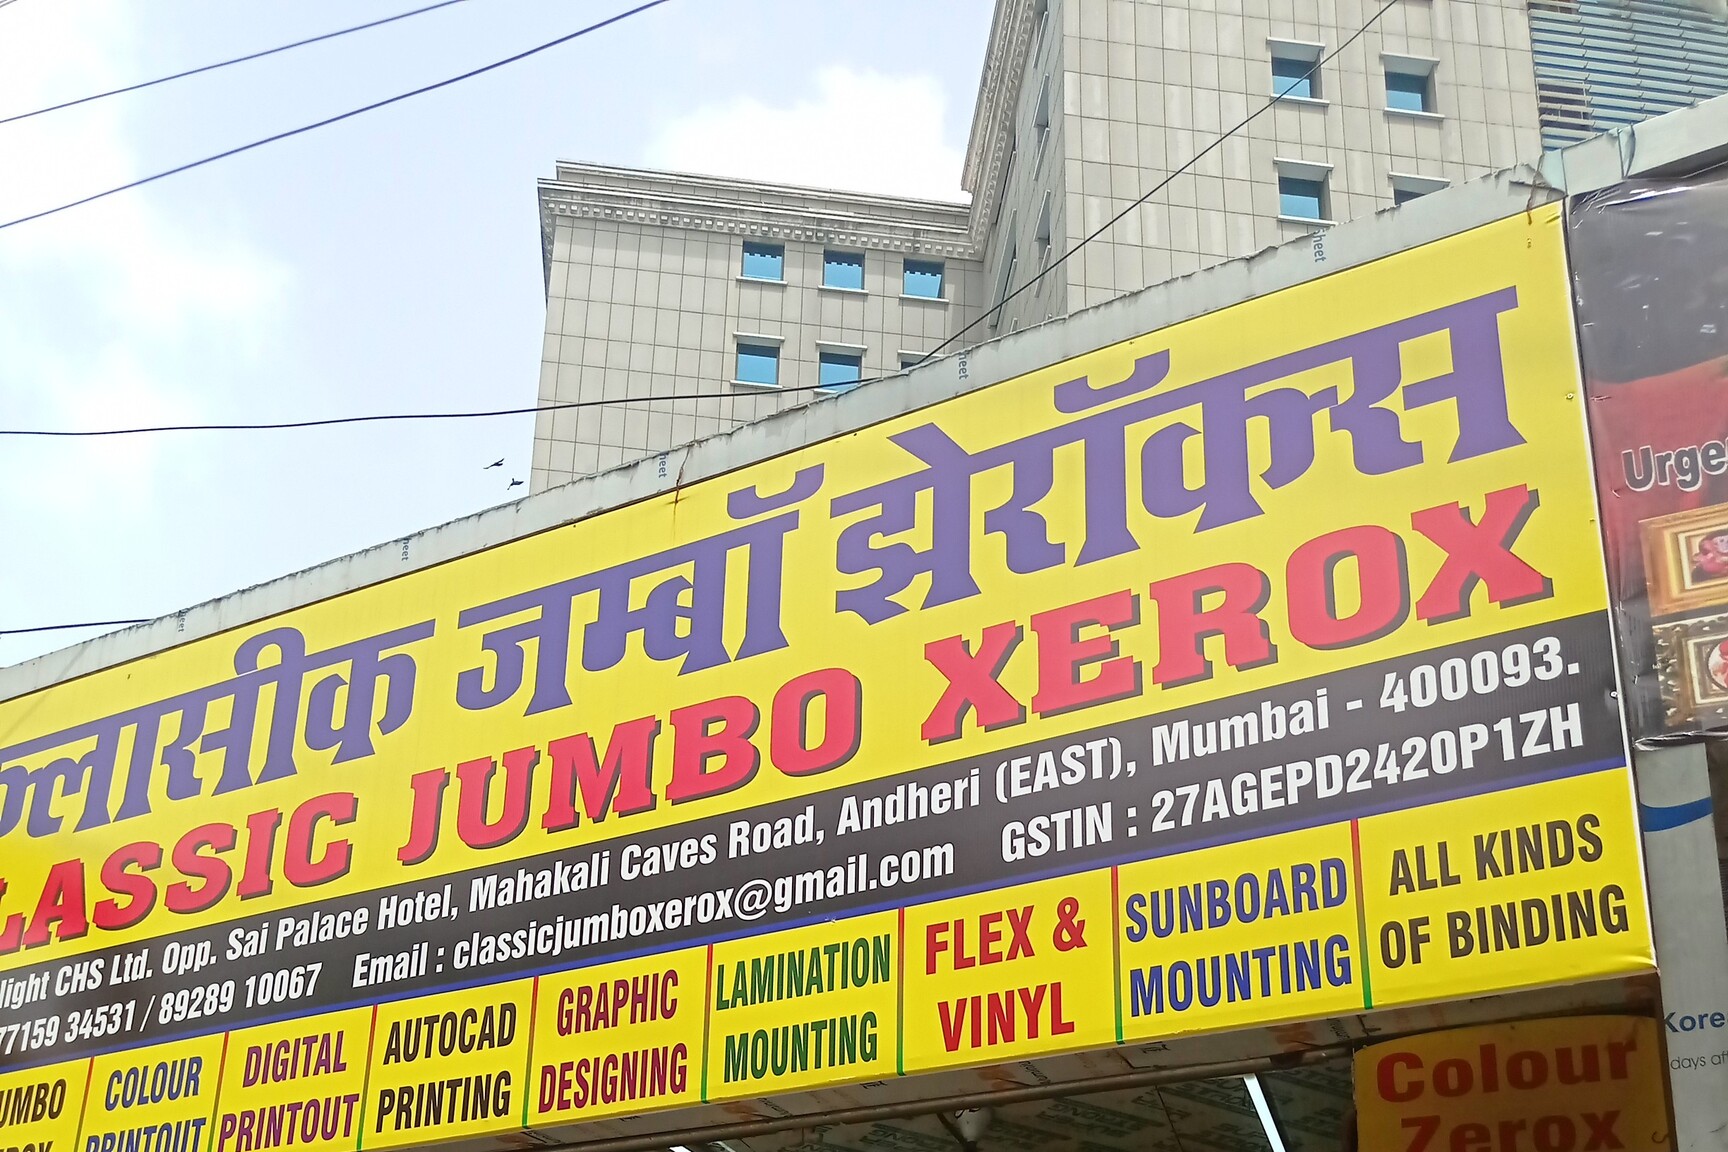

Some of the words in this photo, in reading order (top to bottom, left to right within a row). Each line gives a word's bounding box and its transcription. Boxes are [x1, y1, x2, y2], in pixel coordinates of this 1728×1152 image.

[397, 667, 862, 867] JUMBO
[921, 483, 1555, 744] XEROX
[54, 957, 105, 997] CHS
[109, 948, 154, 992] Ltd.
[161, 940, 218, 980] Opp.
[226, 924, 271, 960] Sai
[277, 906, 369, 952] Palace
[377, 885, 460, 935] Hotel,
[469, 851, 609, 914] Mahakali
[619, 834, 718, 881] Caves
[728, 813, 825, 860] Road,
[837, 768, 981, 836] Andheri
[994, 738, 1136, 804] (EAST),
[1152, 687, 1331, 766] Mumbai
[1379, 636, 1581, 714] 400093.
[1390, 847, 1461, 896] ALL
[1474, 813, 1604, 880] KINDS
[65, 999, 136, 1044] 34531
[140, 1006, 154, 1032] /
[158, 979, 235, 1027] 89289
[244, 963, 323, 1008] 10067
[352, 945, 427, 989] Email
[452, 842, 956, 971] classicjumboxerox@gmail.com
[1000, 802, 1113, 863] GSTIN
[1151, 703, 1584, 833] 27AGEPD2420P1ZH
[1124, 857, 1349, 943] SUNBOARD
[924, 902, 1035, 976] FLEX
[1053, 896, 1088, 952] &
[1379, 916, 1431, 970] OF
[1440, 884, 1629, 958] BINDING
[556, 968, 680, 1037] GRAPHIC
[716, 933, 891, 1011] LAMINATION
[1130, 934, 1352, 1018] MOUNTING
[383, 1001, 517, 1066] AUTOCAD
[723, 1010, 879, 1084] MOUNTING
[937, 981, 1076, 1053] VINYL
[105, 1055, 203, 1112] COLOUR
[242, 1030, 348, 1088] DIGITAL
[538, 1043, 688, 1114] DESIGNING
[1376, 1036, 1638, 1103] Colour
[375, 1070, 512, 1134] PRINTING
